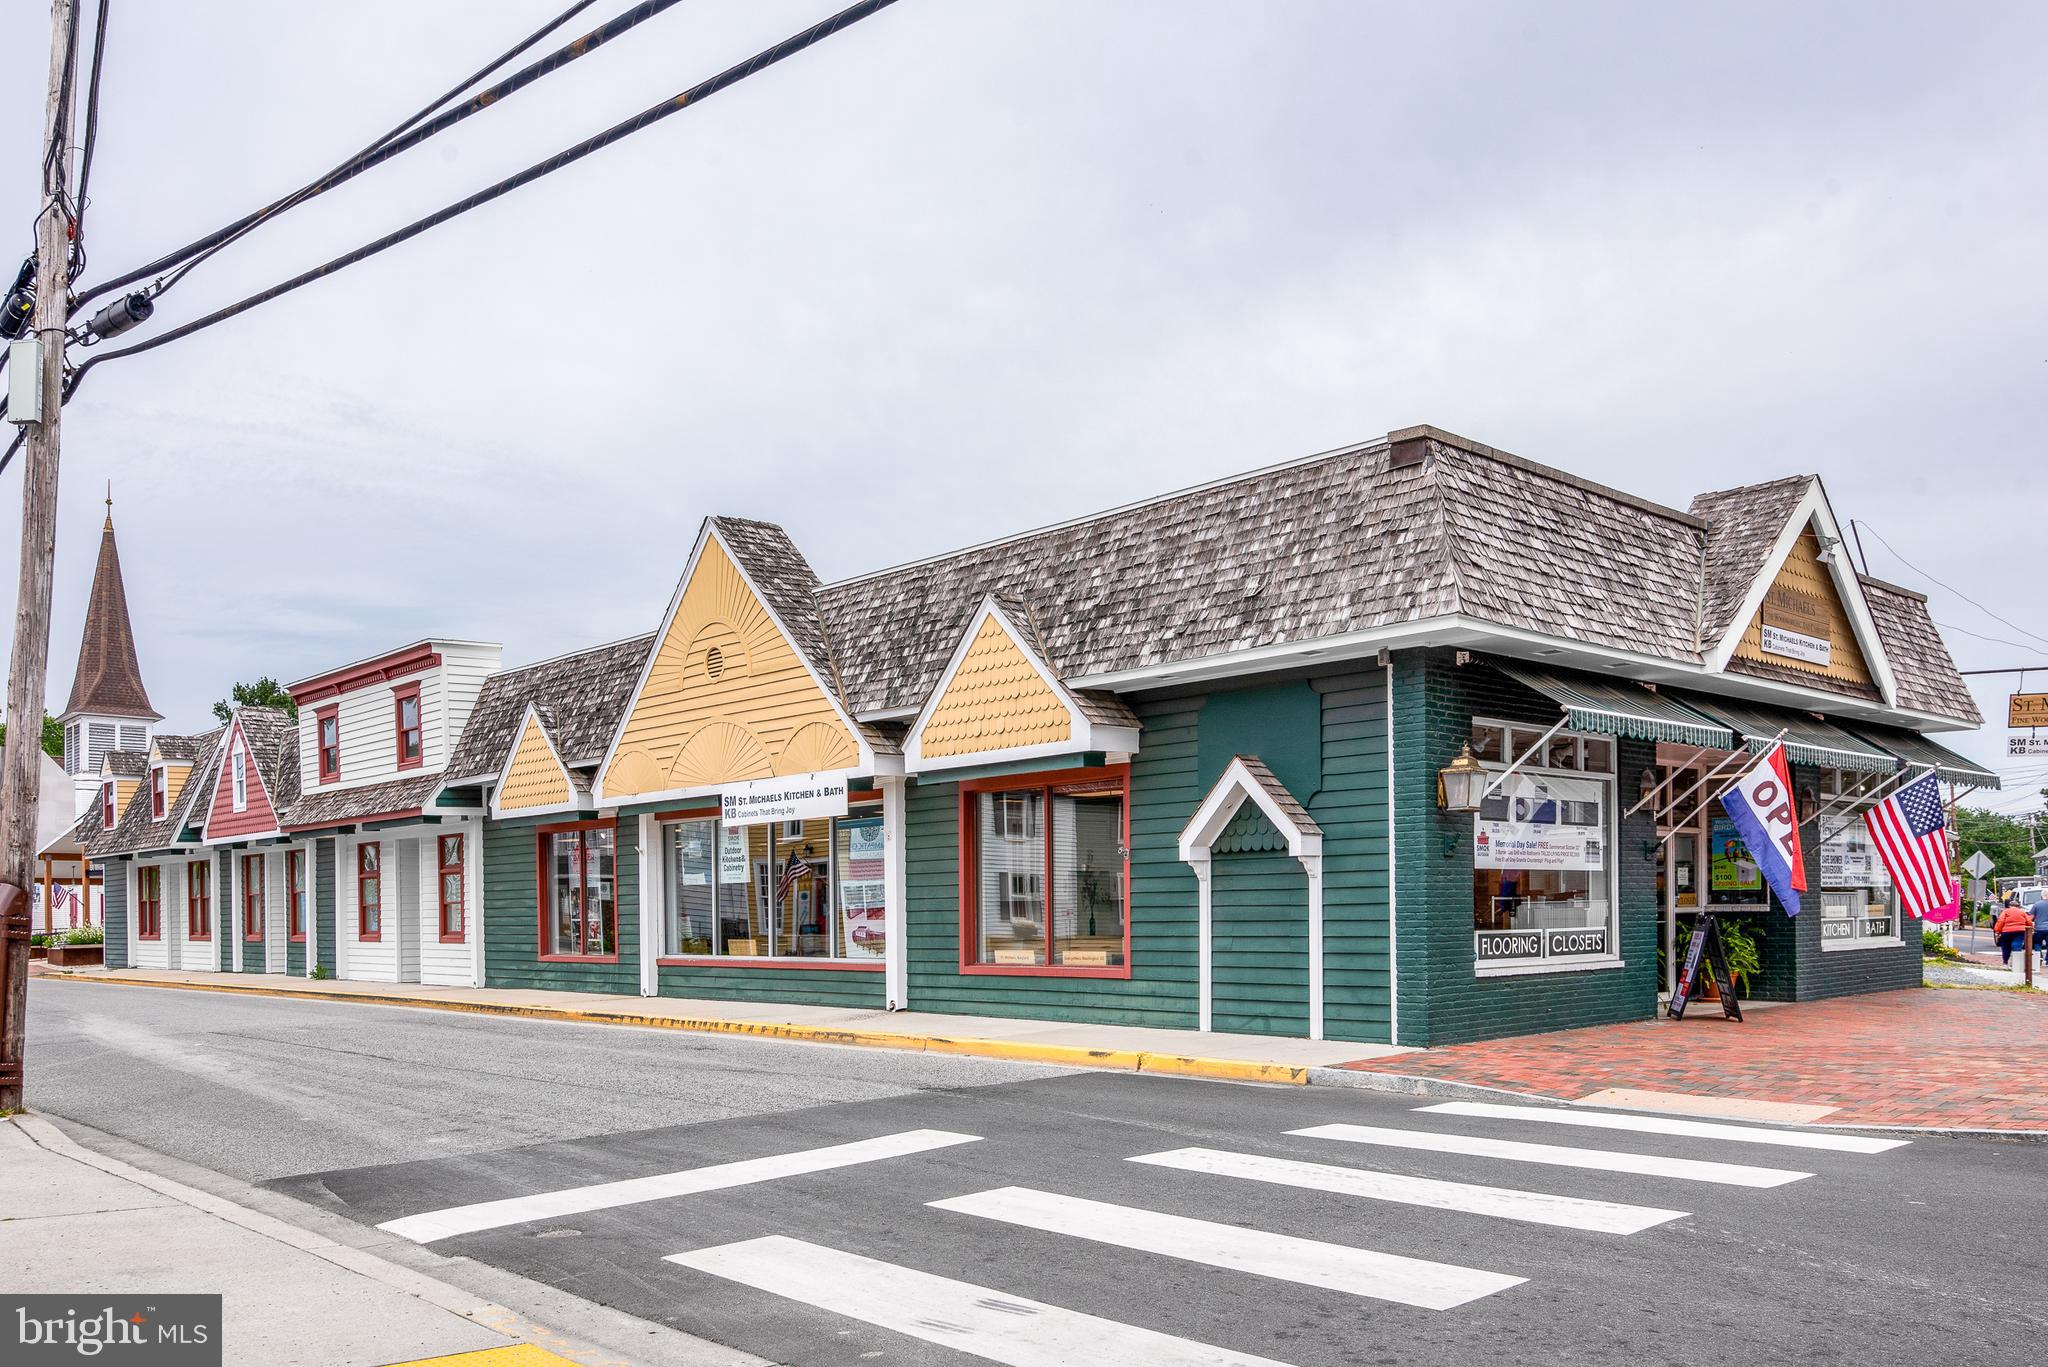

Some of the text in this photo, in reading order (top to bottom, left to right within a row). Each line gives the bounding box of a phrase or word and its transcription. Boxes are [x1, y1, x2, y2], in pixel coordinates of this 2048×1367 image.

[1763, 628, 1772, 638] SM
[1779, 634, 1799, 646] MICHAELS
[1799, 640, 1815, 649] KITCHEN
[1819, 643, 1829, 652] BATH
[1763, 639, 1772, 649] KB
[2012, 698, 2036, 711] ST.
[2010, 738, 2027, 746] SM
[2010, 746, 2026, 754] KB
[724, 796, 737, 807] SM
[749, 793, 782, 805] MICHAELS
[784, 789, 815, 801] KITCHEN
[816, 788, 822, 797] &
[824, 786, 844, 797] BATH
[724, 805, 796, 819] KB Cabinets That Bring Joy
[1495, 840, 1516, 849] Memorial
[1516, 840, 1525, 850] Day
[1526, 841, 1537, 849] Sale!
[1537, 841, 1549, 850] FREE
[724, 847, 742, 855] Outdoor
[723, 864, 745, 873] Cabinetry
[1823, 921, 1885, 936] KITCHEN BATH
[1481, 934, 1602, 955] FLOORING CLOSETS
